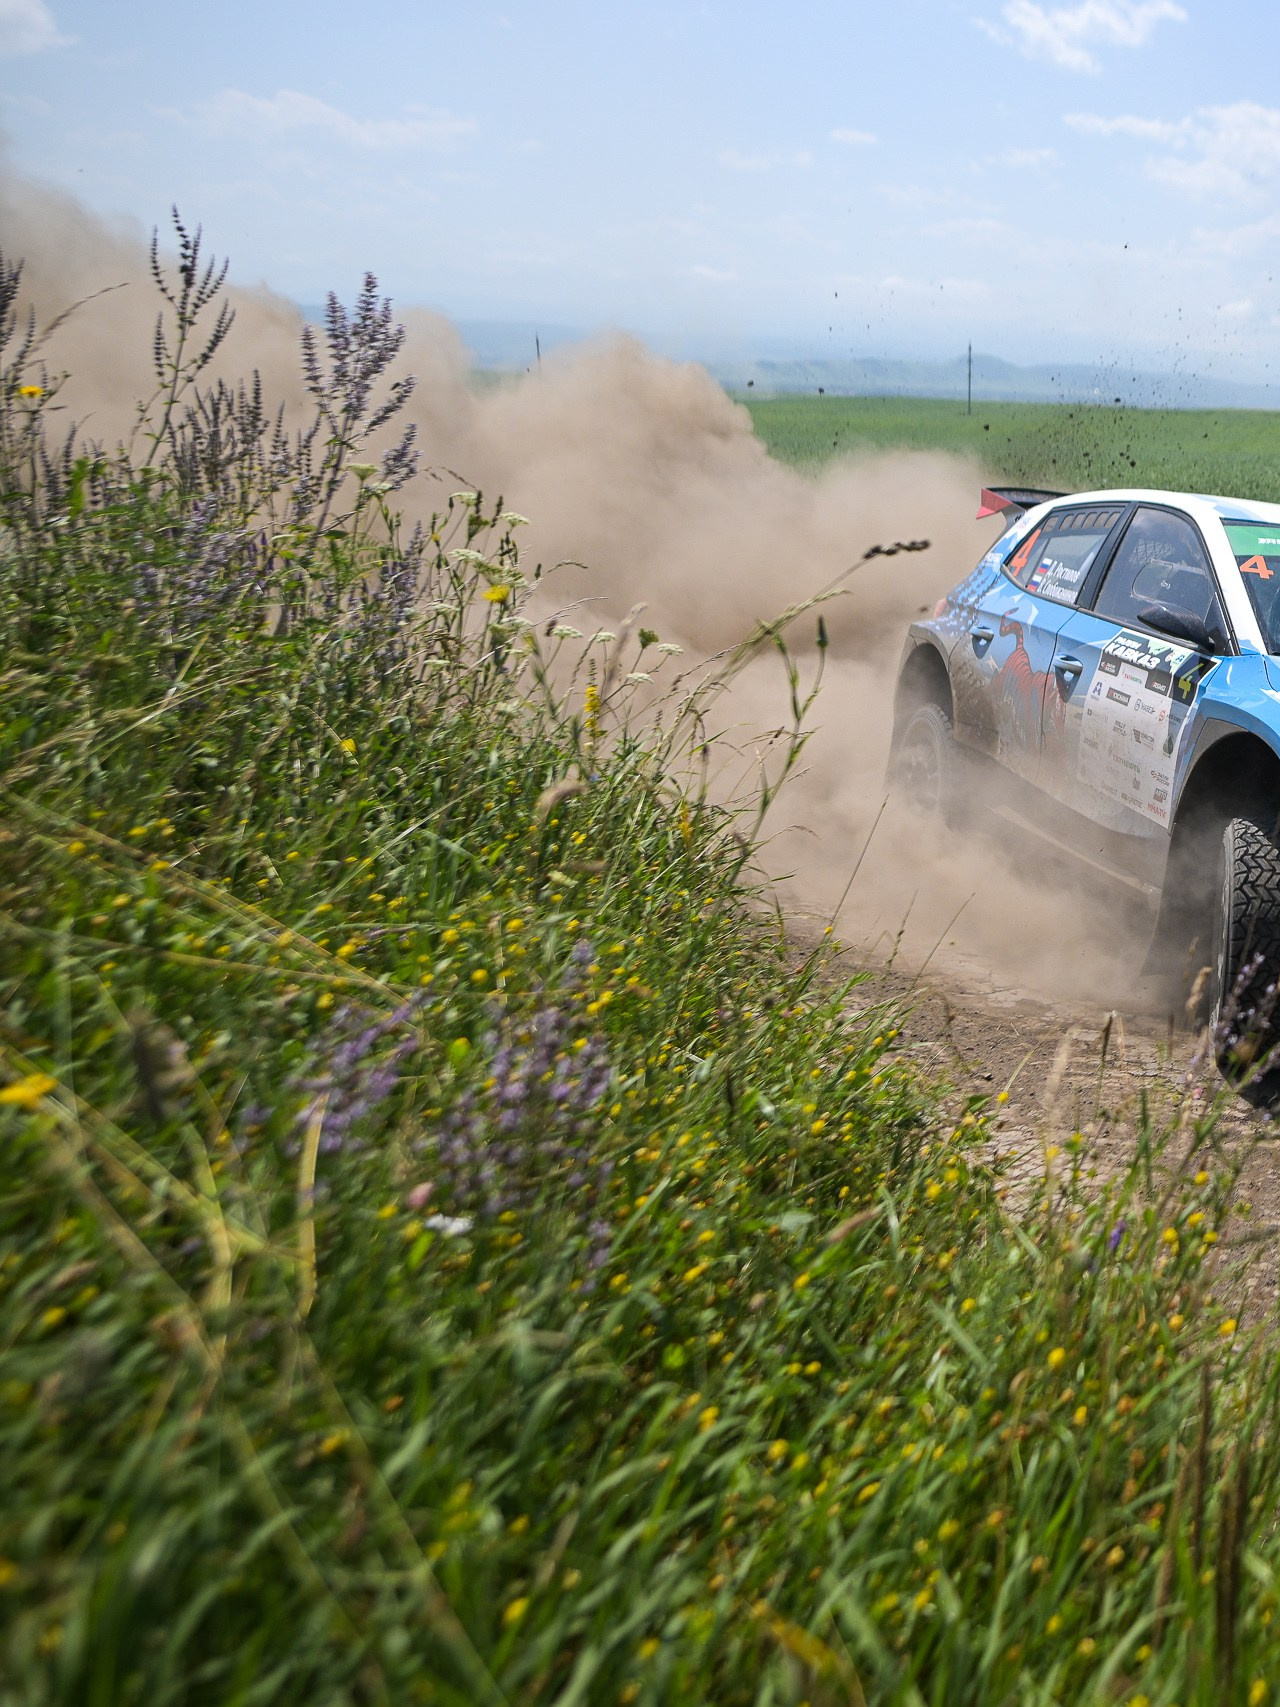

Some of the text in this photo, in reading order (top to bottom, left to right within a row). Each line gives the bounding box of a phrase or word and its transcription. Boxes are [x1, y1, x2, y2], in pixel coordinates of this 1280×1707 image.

[1010, 528, 1041, 577] 4
[1240, 555, 1274, 579] 4
[1104, 642, 1160, 669] КАВКАЗ
[1178, 663, 1205, 699] 4
